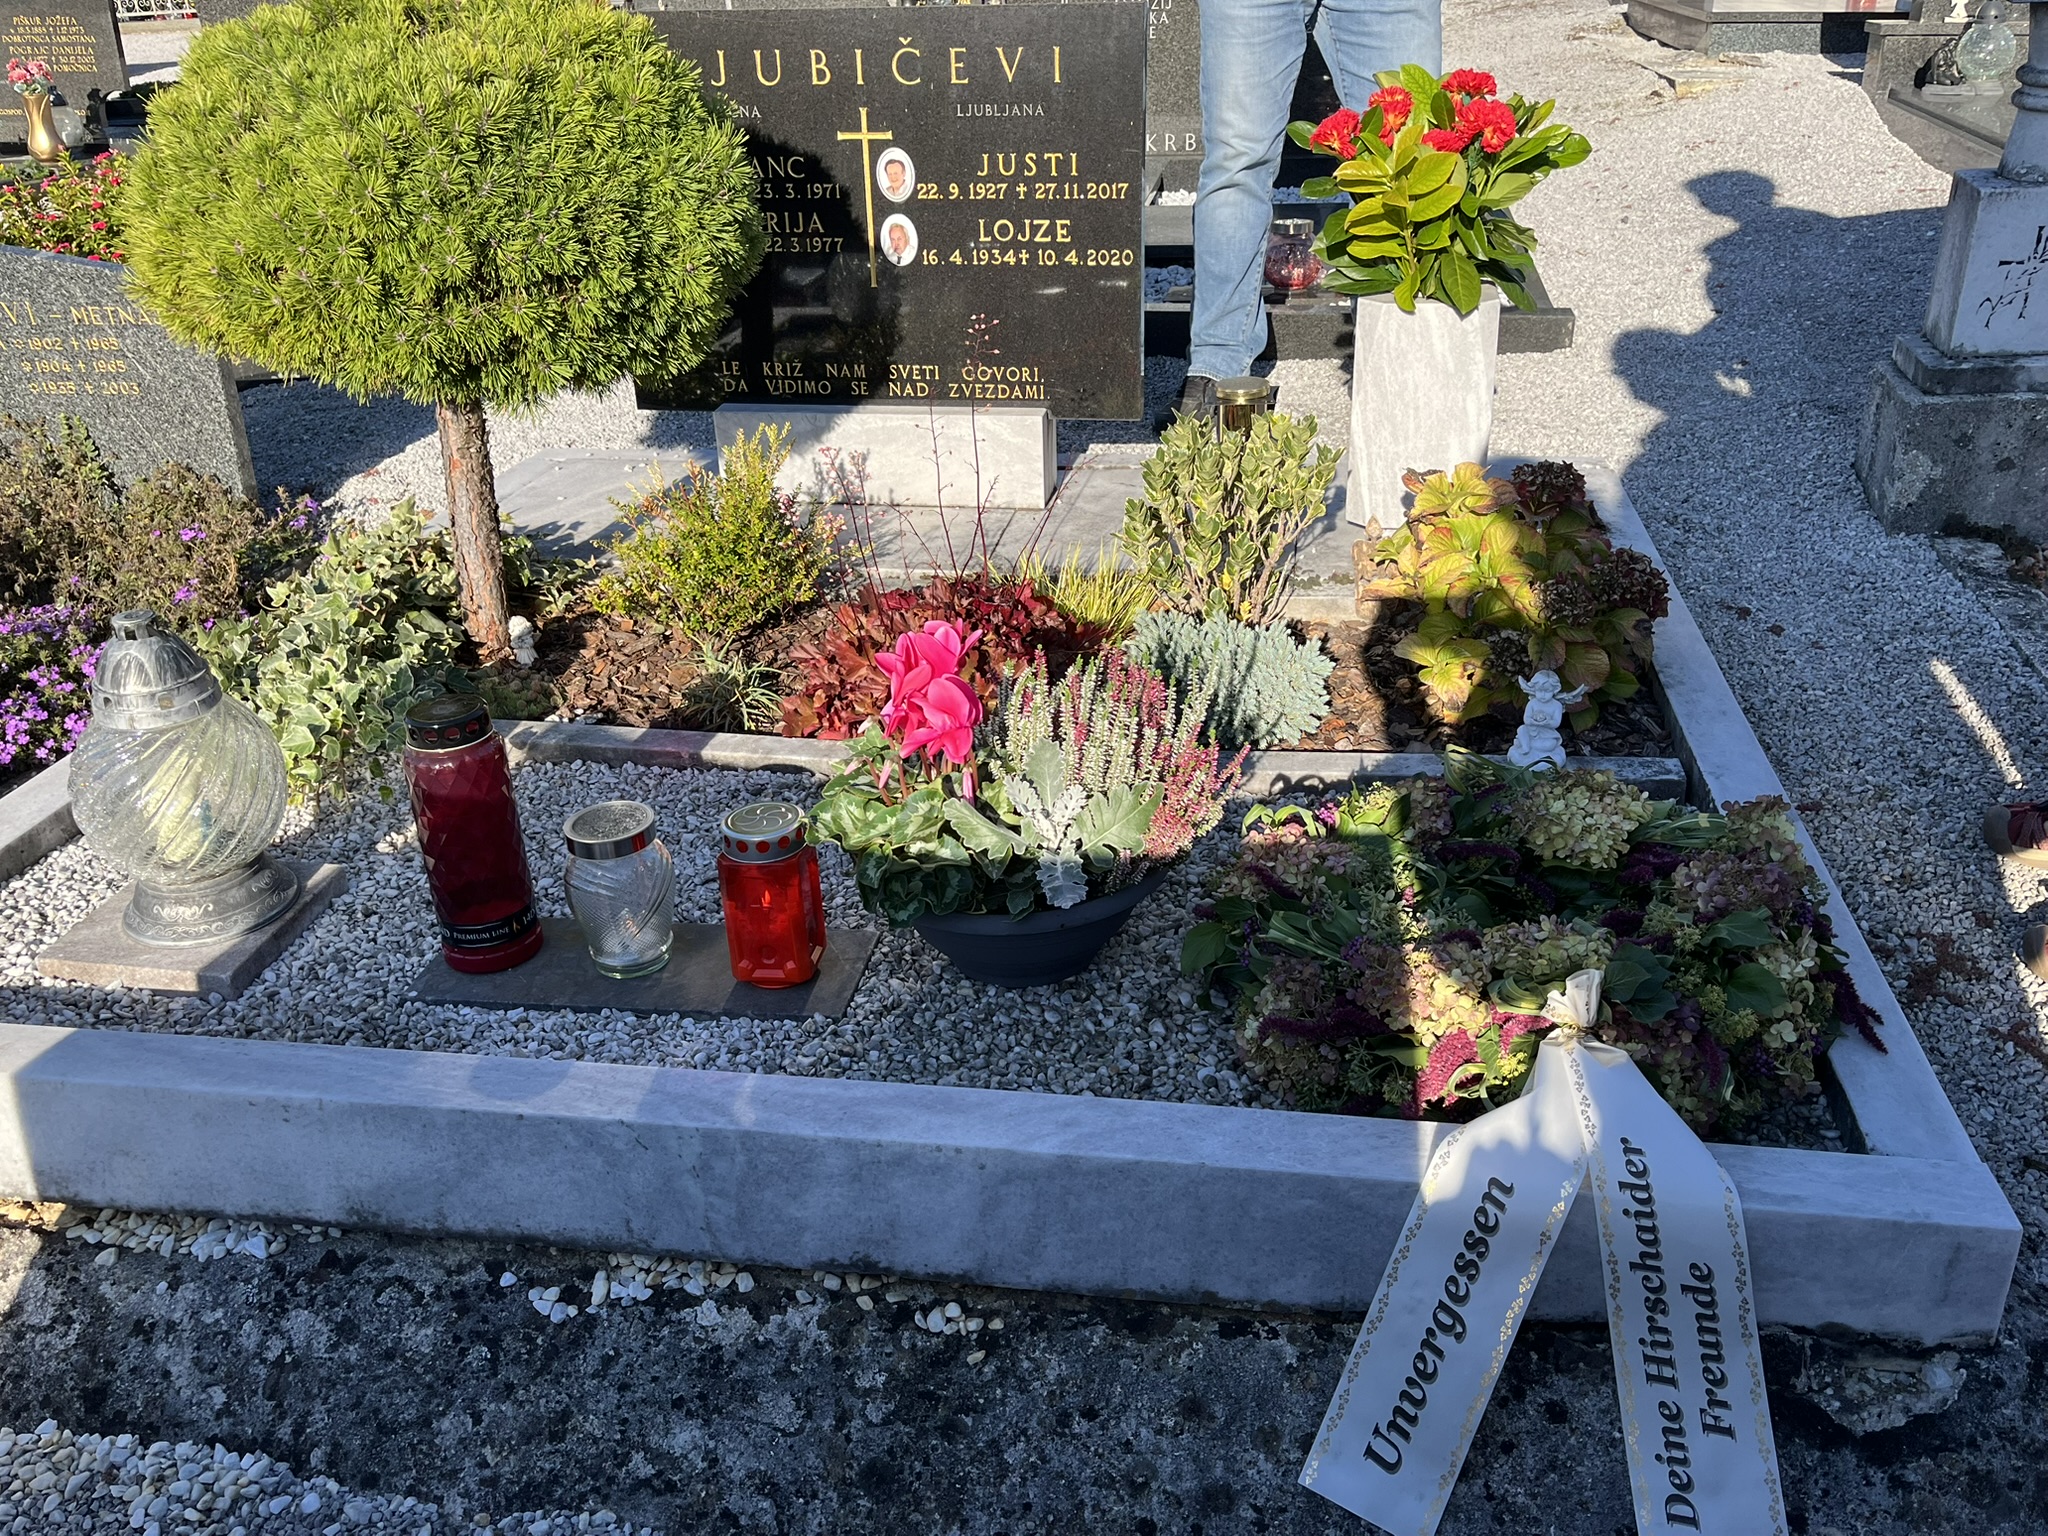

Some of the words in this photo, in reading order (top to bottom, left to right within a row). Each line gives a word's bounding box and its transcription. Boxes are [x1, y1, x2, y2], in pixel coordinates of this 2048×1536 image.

[1149, 11, 1169, 24] KA
[710, 37, 1061, 86] JUBIČEVI
[956, 104, 1045, 117] LJUBLJANA
[751, 156, 806, 178] ANC
[977, 153, 1078, 177] JUSTI
[766, 211, 825, 233] RIJA
[978, 219, 1072, 242] LOJZE
[0, 300, 37, 325] VI
[722, 361, 741, 375] LE
[762, 359, 804, 376] KRIŽ
[825, 363, 867, 378] NAM
[889, 364, 940, 380] SVETI
[723, 379, 748, 393] DA
[765, 379, 832, 394] VIDIMO
[851, 381, 869, 395] SE
[888, 382, 929, 397] NAD
[453, 931, 491, 940] PREMIUM
[492, 926, 510, 938] LINE
[1617, 1136, 1681, 1392] Hirschaider
[1362, 1175, 1516, 1475] Unvergessen
[1680, 1261, 1738, 1441] Freunde
[1654, 1398, 1700, 1531] Deine
